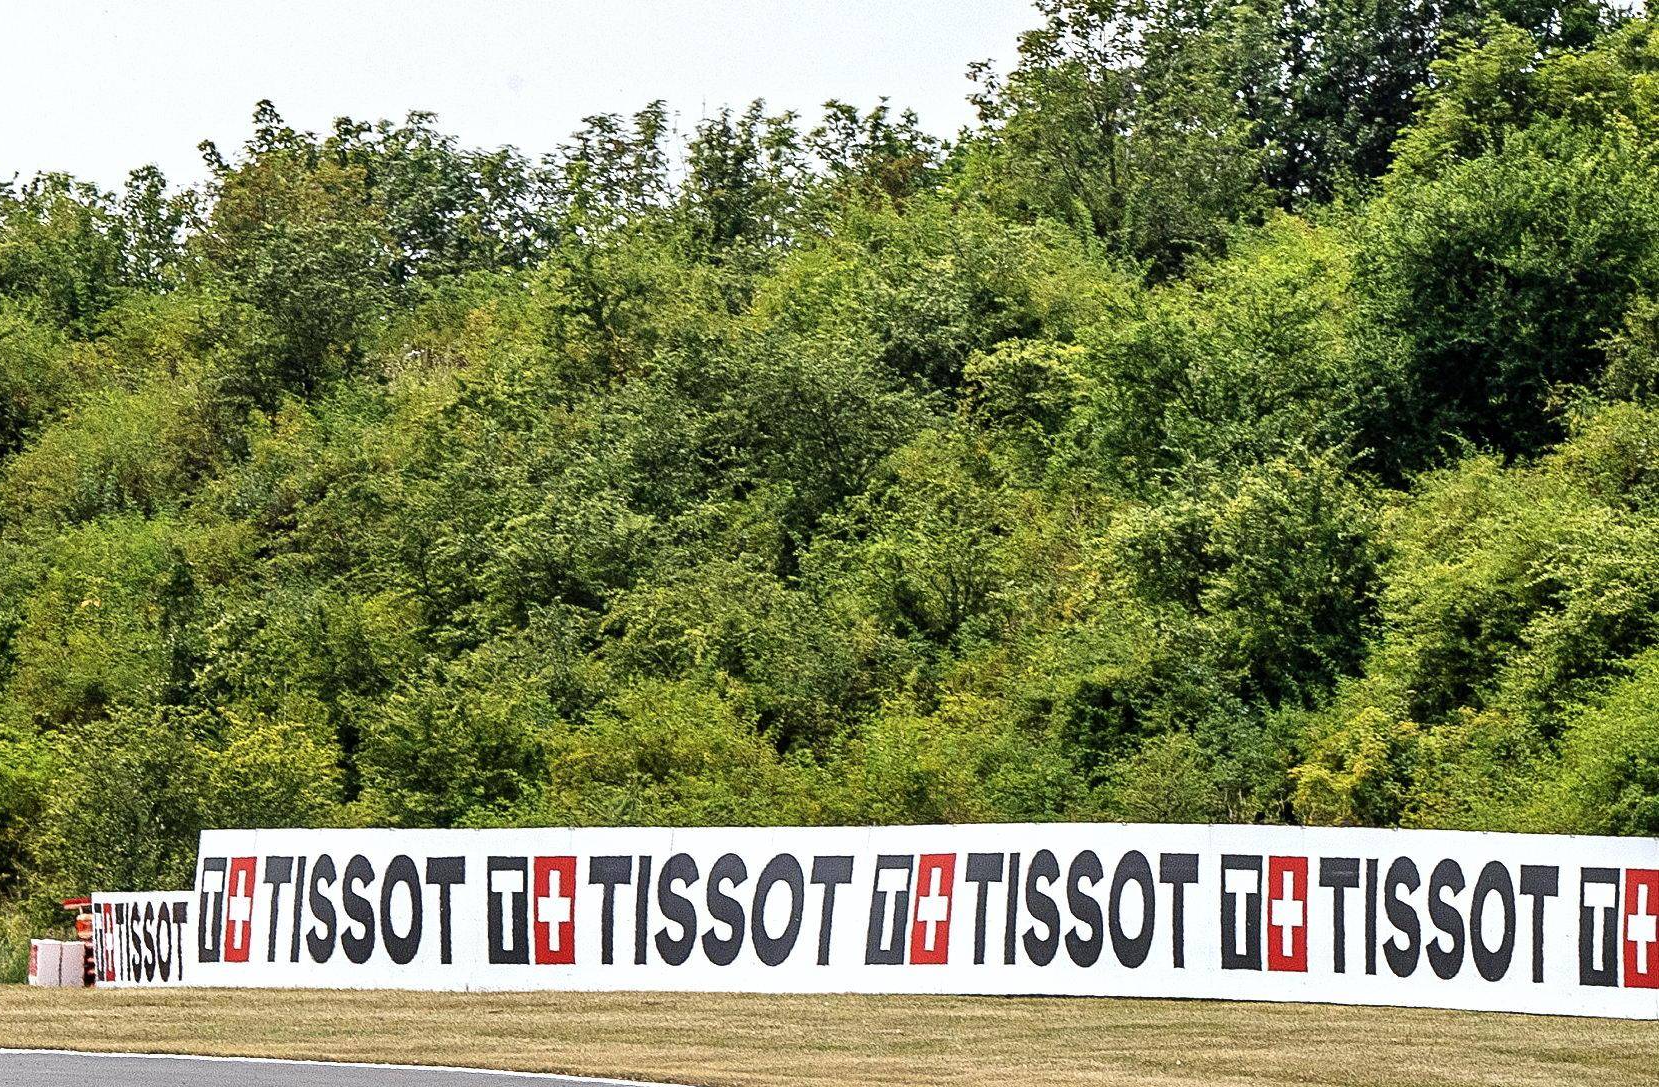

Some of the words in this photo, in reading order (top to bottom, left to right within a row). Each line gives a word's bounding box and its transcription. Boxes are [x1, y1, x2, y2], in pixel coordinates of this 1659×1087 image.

[115, 902, 188, 983] TISSOT
[263, 854, 465, 964] TISSOT
[588, 853, 852, 966] TISSOT
[965, 849, 1199, 968] TISSOT
[1319, 856, 1559, 983] TISSOT
